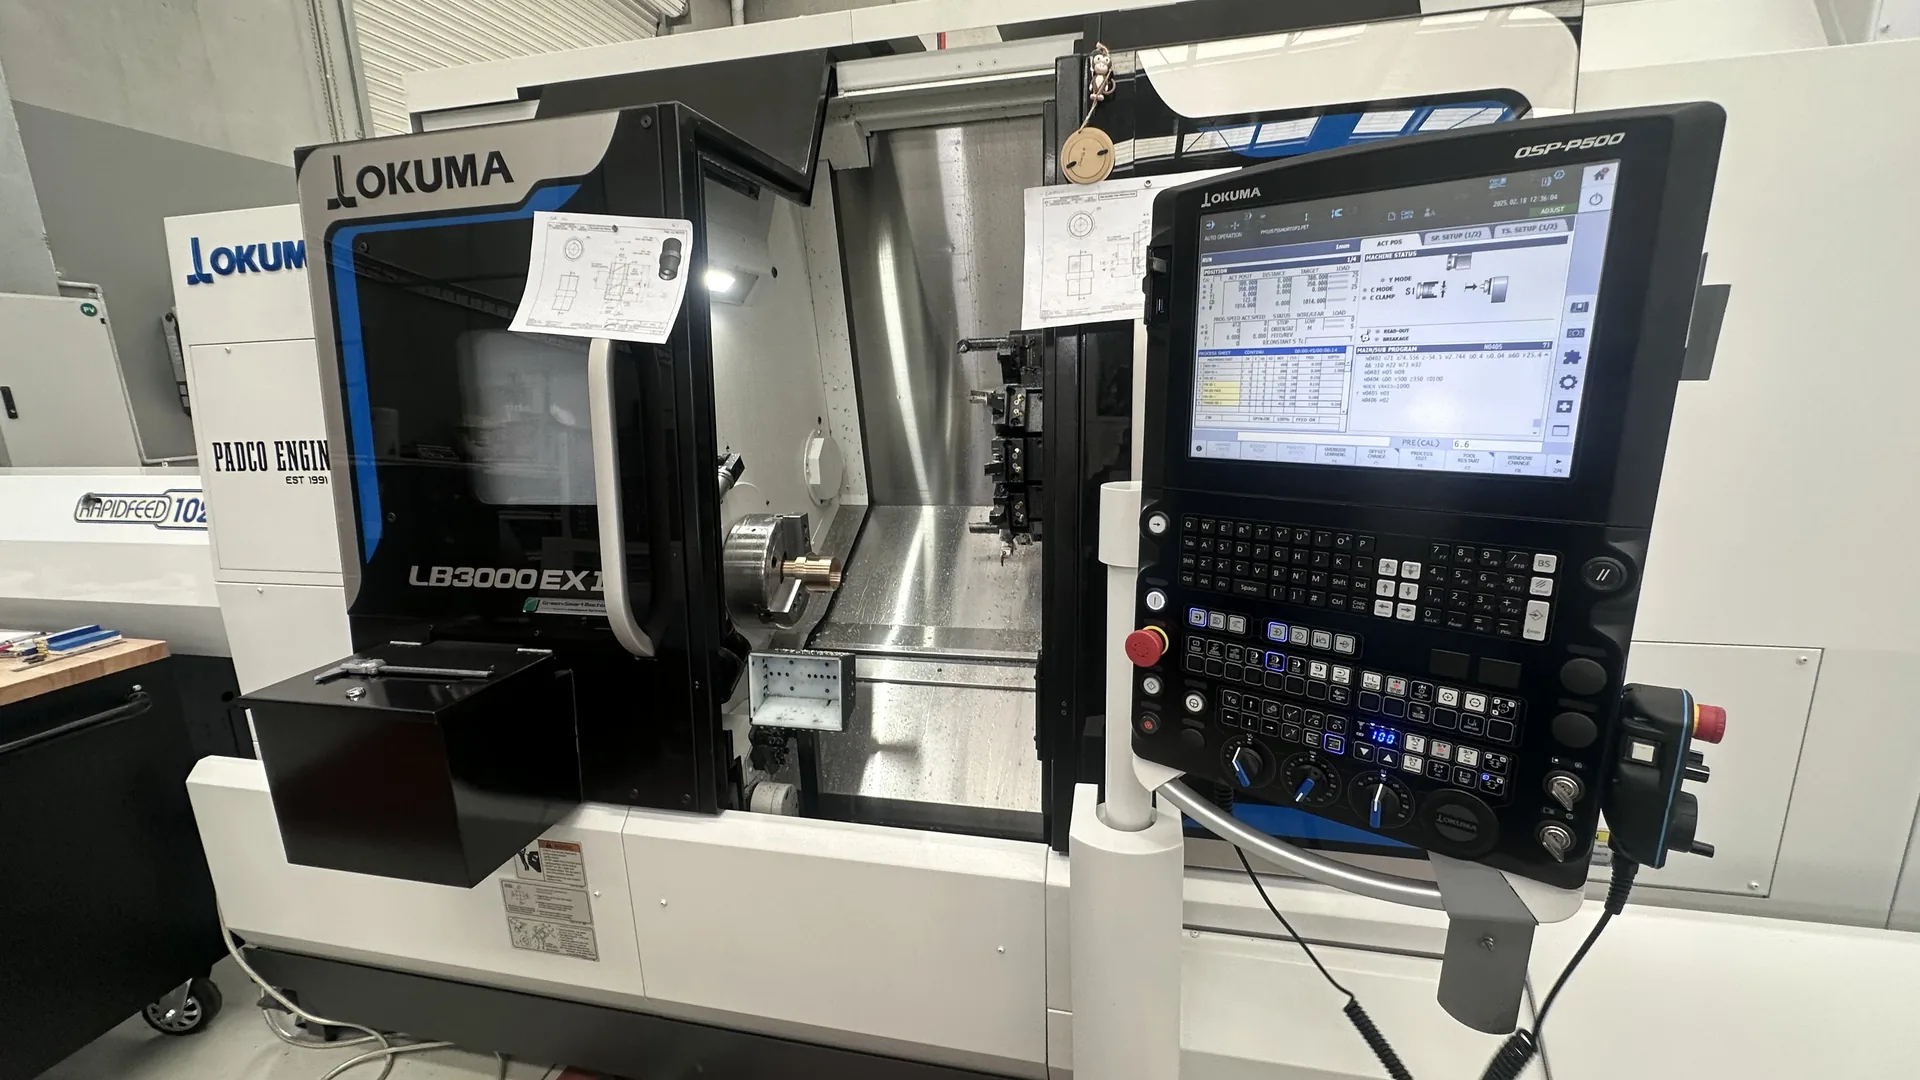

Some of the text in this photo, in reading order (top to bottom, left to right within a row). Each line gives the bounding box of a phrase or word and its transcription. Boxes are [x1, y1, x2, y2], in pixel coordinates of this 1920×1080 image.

[1513, 132, 1626, 159] OSP-P500
[356, 151, 514, 199] OKUMA
[1211, 187, 1261, 204] OKUMA
[1540, 206, 1565, 214] ADJUST
[1539, 223, 1558, 232] (1/2)
[1464, 231, 1482, 239] (1/2)
[1402, 439, 1469, 449] PRE(CAL) 6.6
[212, 441, 268, 472] PADCO
[285, 476, 328, 484] EST 1991
[1201, 522, 1210, 530] W
[1257, 528, 1263, 536] T
[1276, 530, 1283, 538] Y
[1337, 537, 1344, 545] O
[1219, 543, 1225, 551] S
[1274, 550, 1281, 558] G
[1457, 548, 1464, 556] 8
[1483, 551, 1490, 559] 9
[1182, 557, 1194, 565] Shift
[1357, 560, 1363, 568] L
[1537, 559, 1551, 568] BS
[1273, 569, 1279, 577] B
[1455, 570, 1461, 578] 5
[1480, 573, 1487, 581] 6
[408, 565, 538, 590] LB3000
[1200, 577, 1209, 585] Alt
[1332, 578, 1346, 586] Shift
[1240, 584, 1258, 592] Space
[1452, 592, 1458, 600] 2
[1476, 595, 1483, 603] 3
[1424, 609, 1431, 617] 0
[1372, 730, 1396, 744] 100
